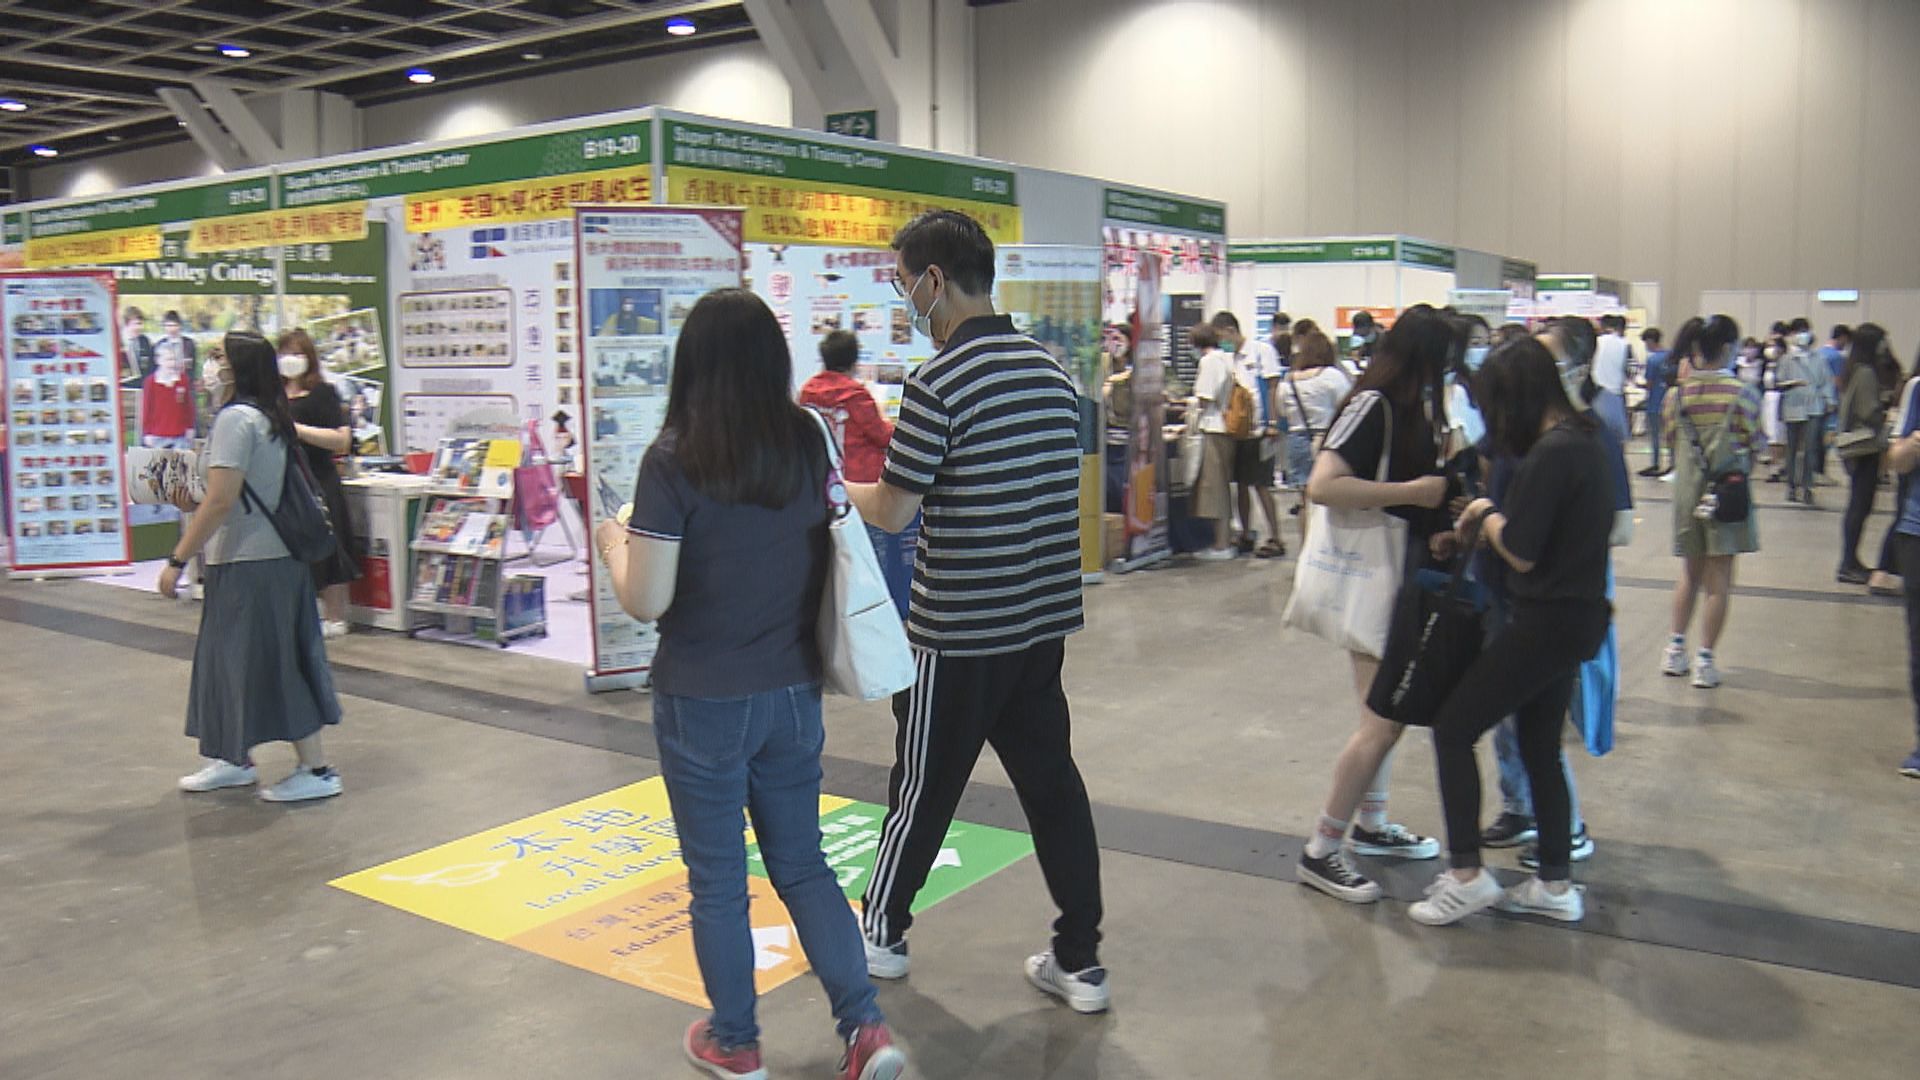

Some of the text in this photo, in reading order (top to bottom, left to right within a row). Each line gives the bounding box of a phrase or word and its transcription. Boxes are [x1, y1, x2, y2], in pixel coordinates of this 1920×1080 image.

[583, 134, 641, 159] B19-20
[146, 262, 209, 286] Valley
[211, 262, 276, 288] Colleg
[488, 808, 651, 860] 本地
[525, 848, 684, 911] Local Educa
